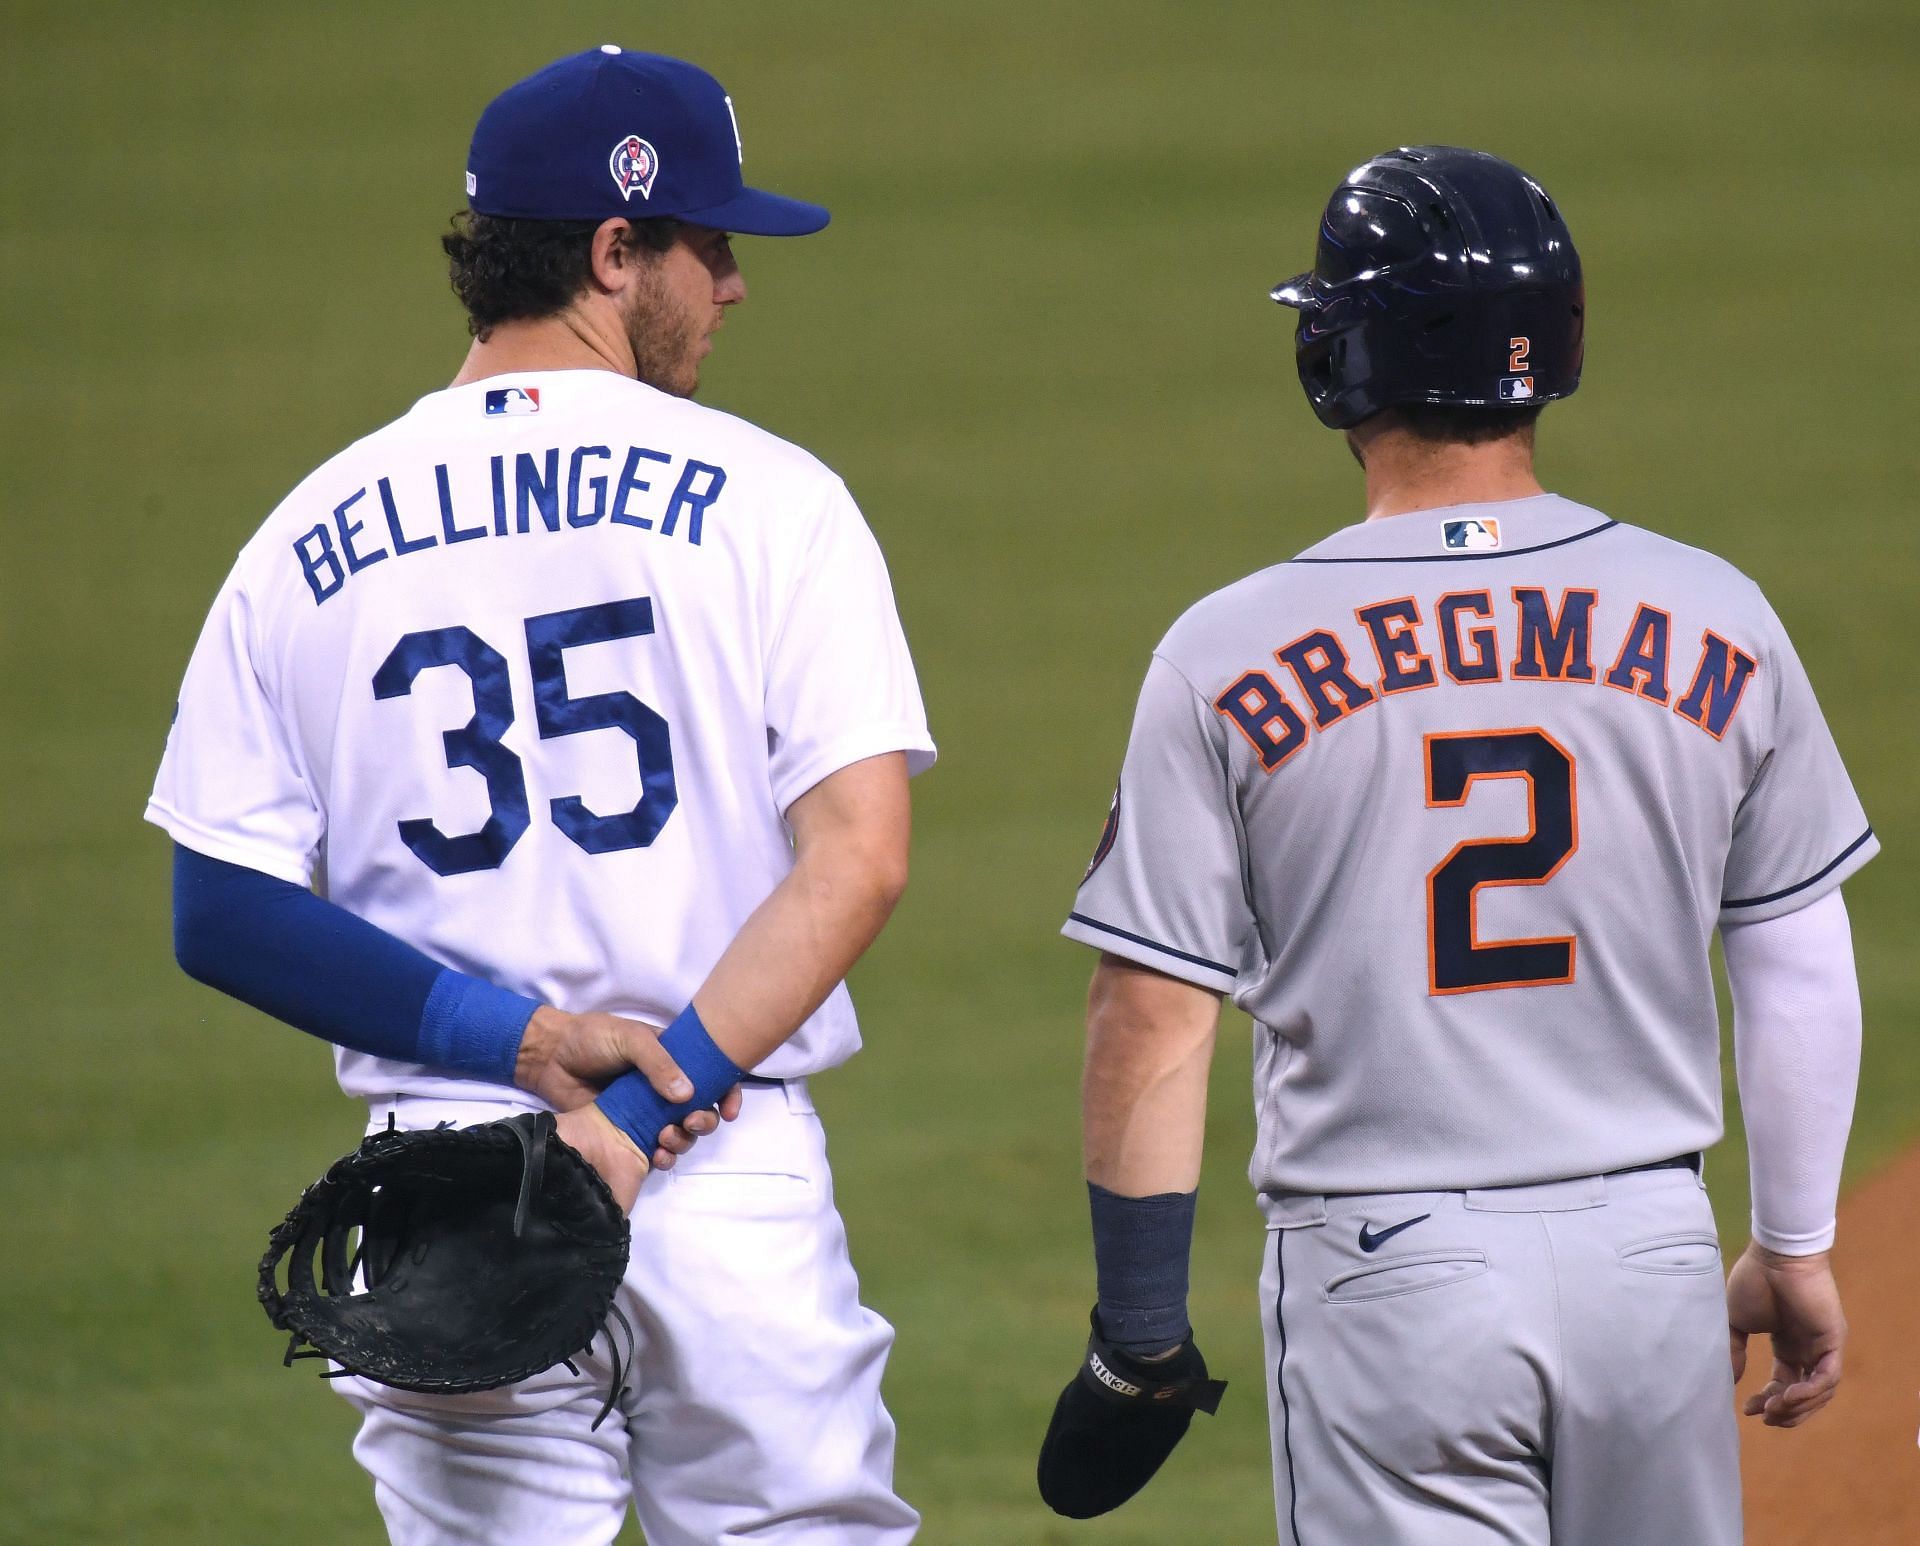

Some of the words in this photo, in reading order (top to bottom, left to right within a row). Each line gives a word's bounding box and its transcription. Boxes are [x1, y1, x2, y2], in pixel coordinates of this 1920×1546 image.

[1510, 338, 1530, 371] 2
[294, 446, 726, 606] BELLINGER
[372, 597, 678, 877] 35
[1216, 586, 1757, 772] BREGMAN
[1423, 727, 1579, 996] 2
